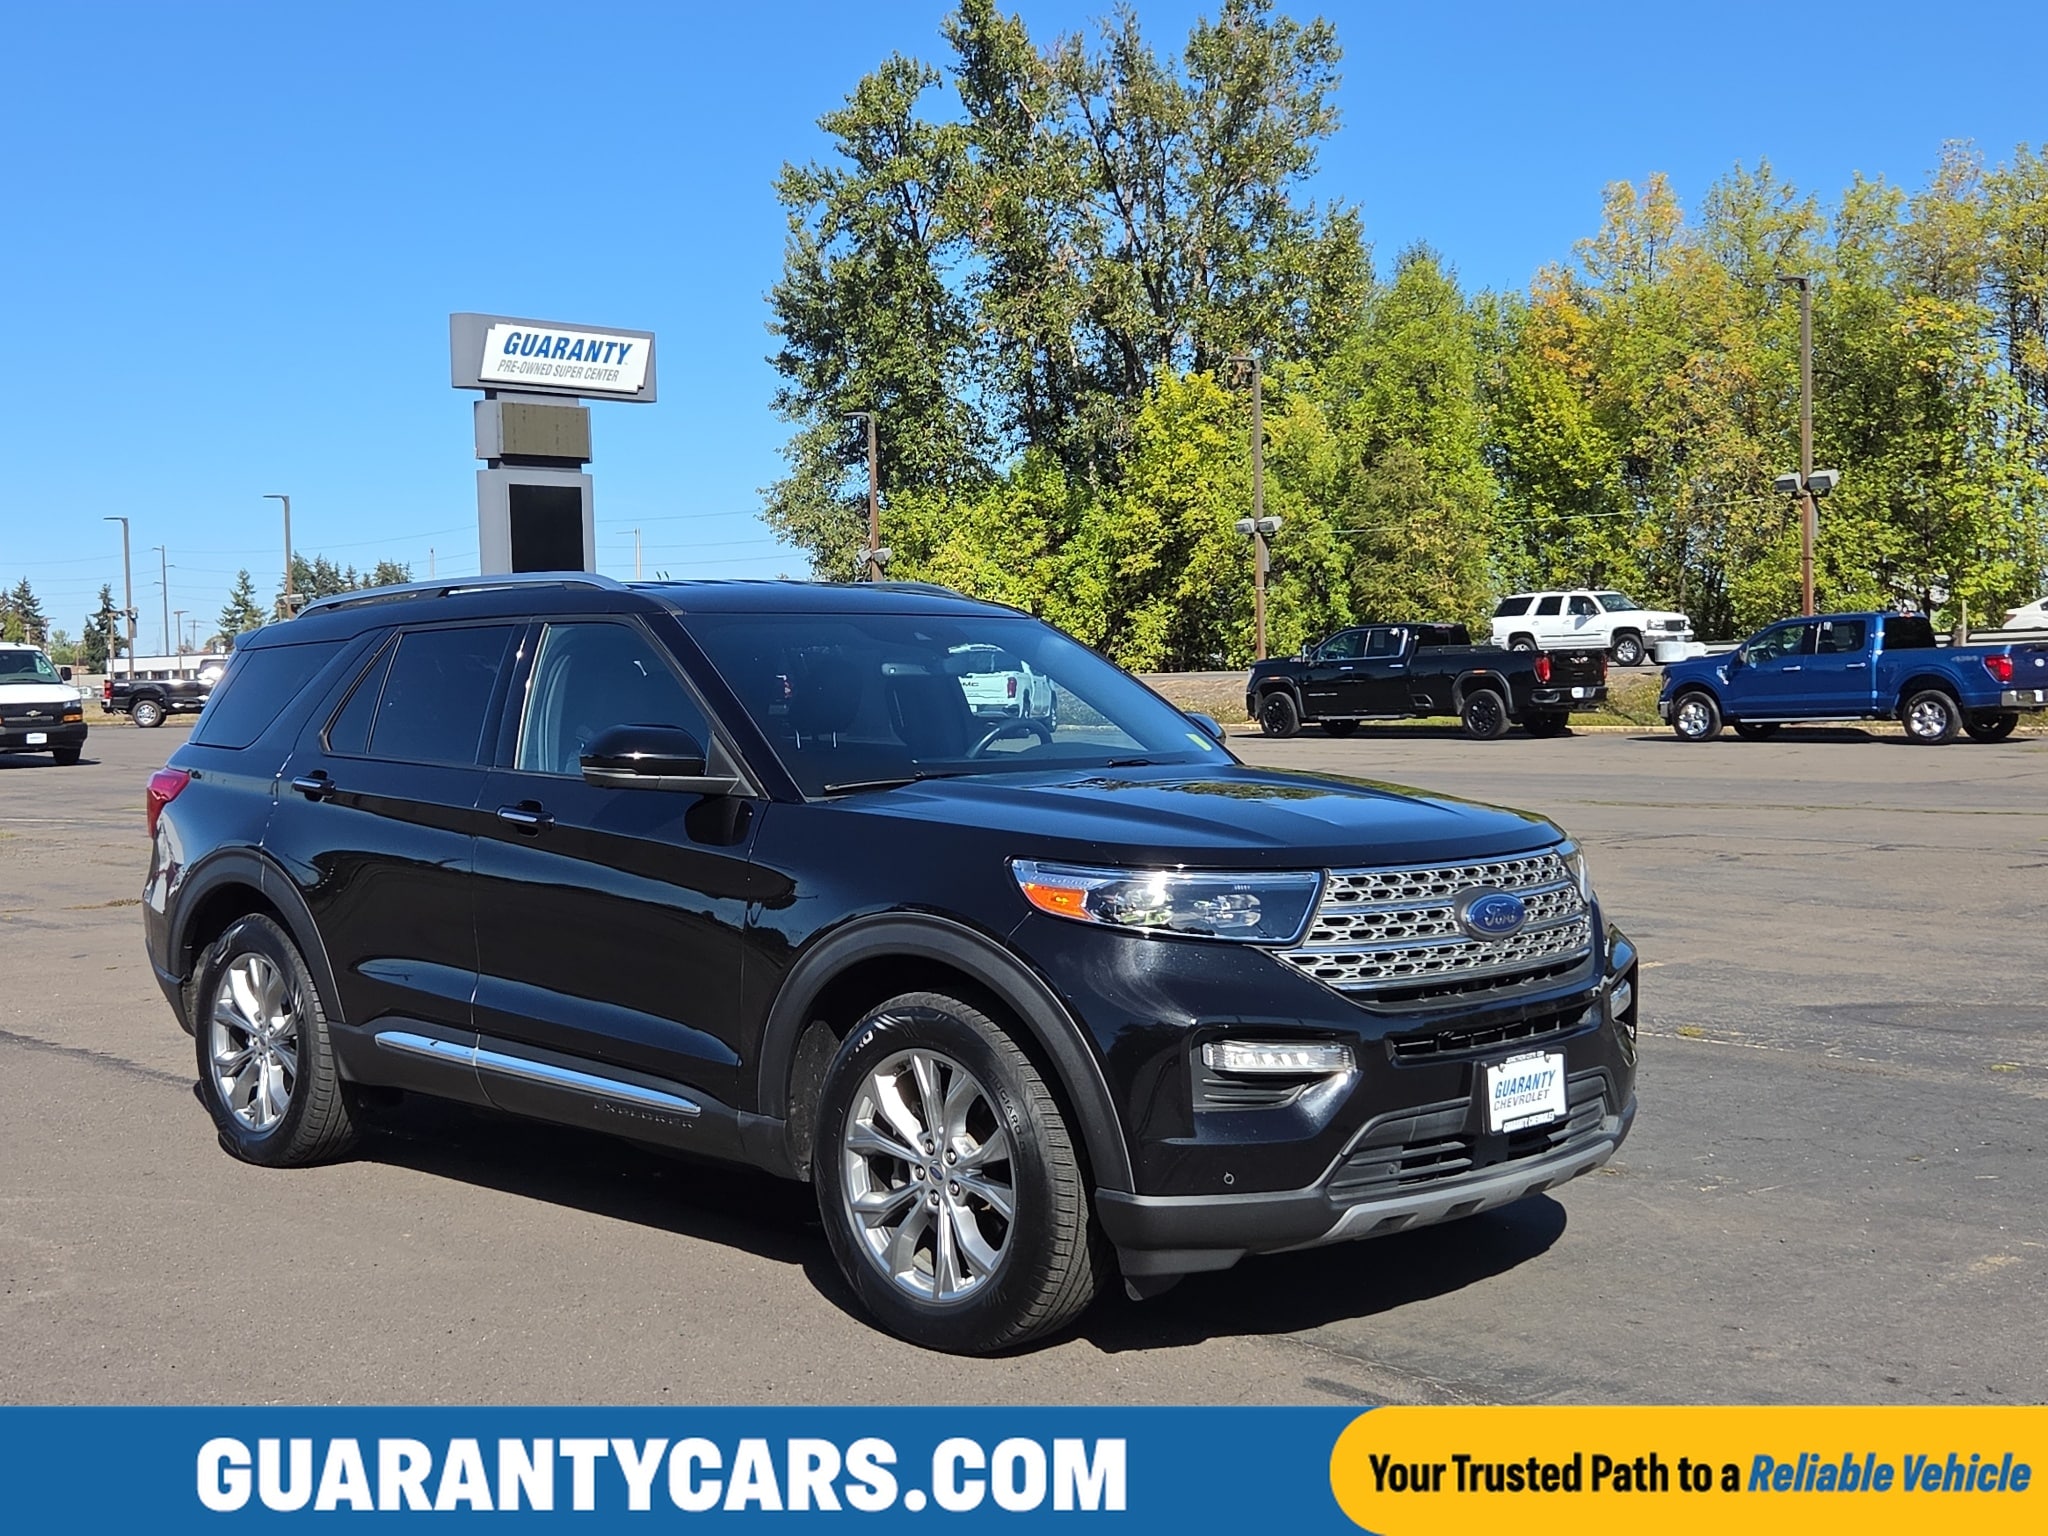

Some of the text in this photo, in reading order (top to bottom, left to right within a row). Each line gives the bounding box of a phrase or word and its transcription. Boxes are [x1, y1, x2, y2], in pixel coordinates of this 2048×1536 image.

[503, 332, 633, 365] GUARANTY
[497, 359, 620, 382] PRE-OWNED SUPER CENTER
[1484, 902, 1516, 926] Ford
[1495, 1069, 1556, 1099] GUARANTY
[1493, 1089, 1550, 1112] CHEVROLET
